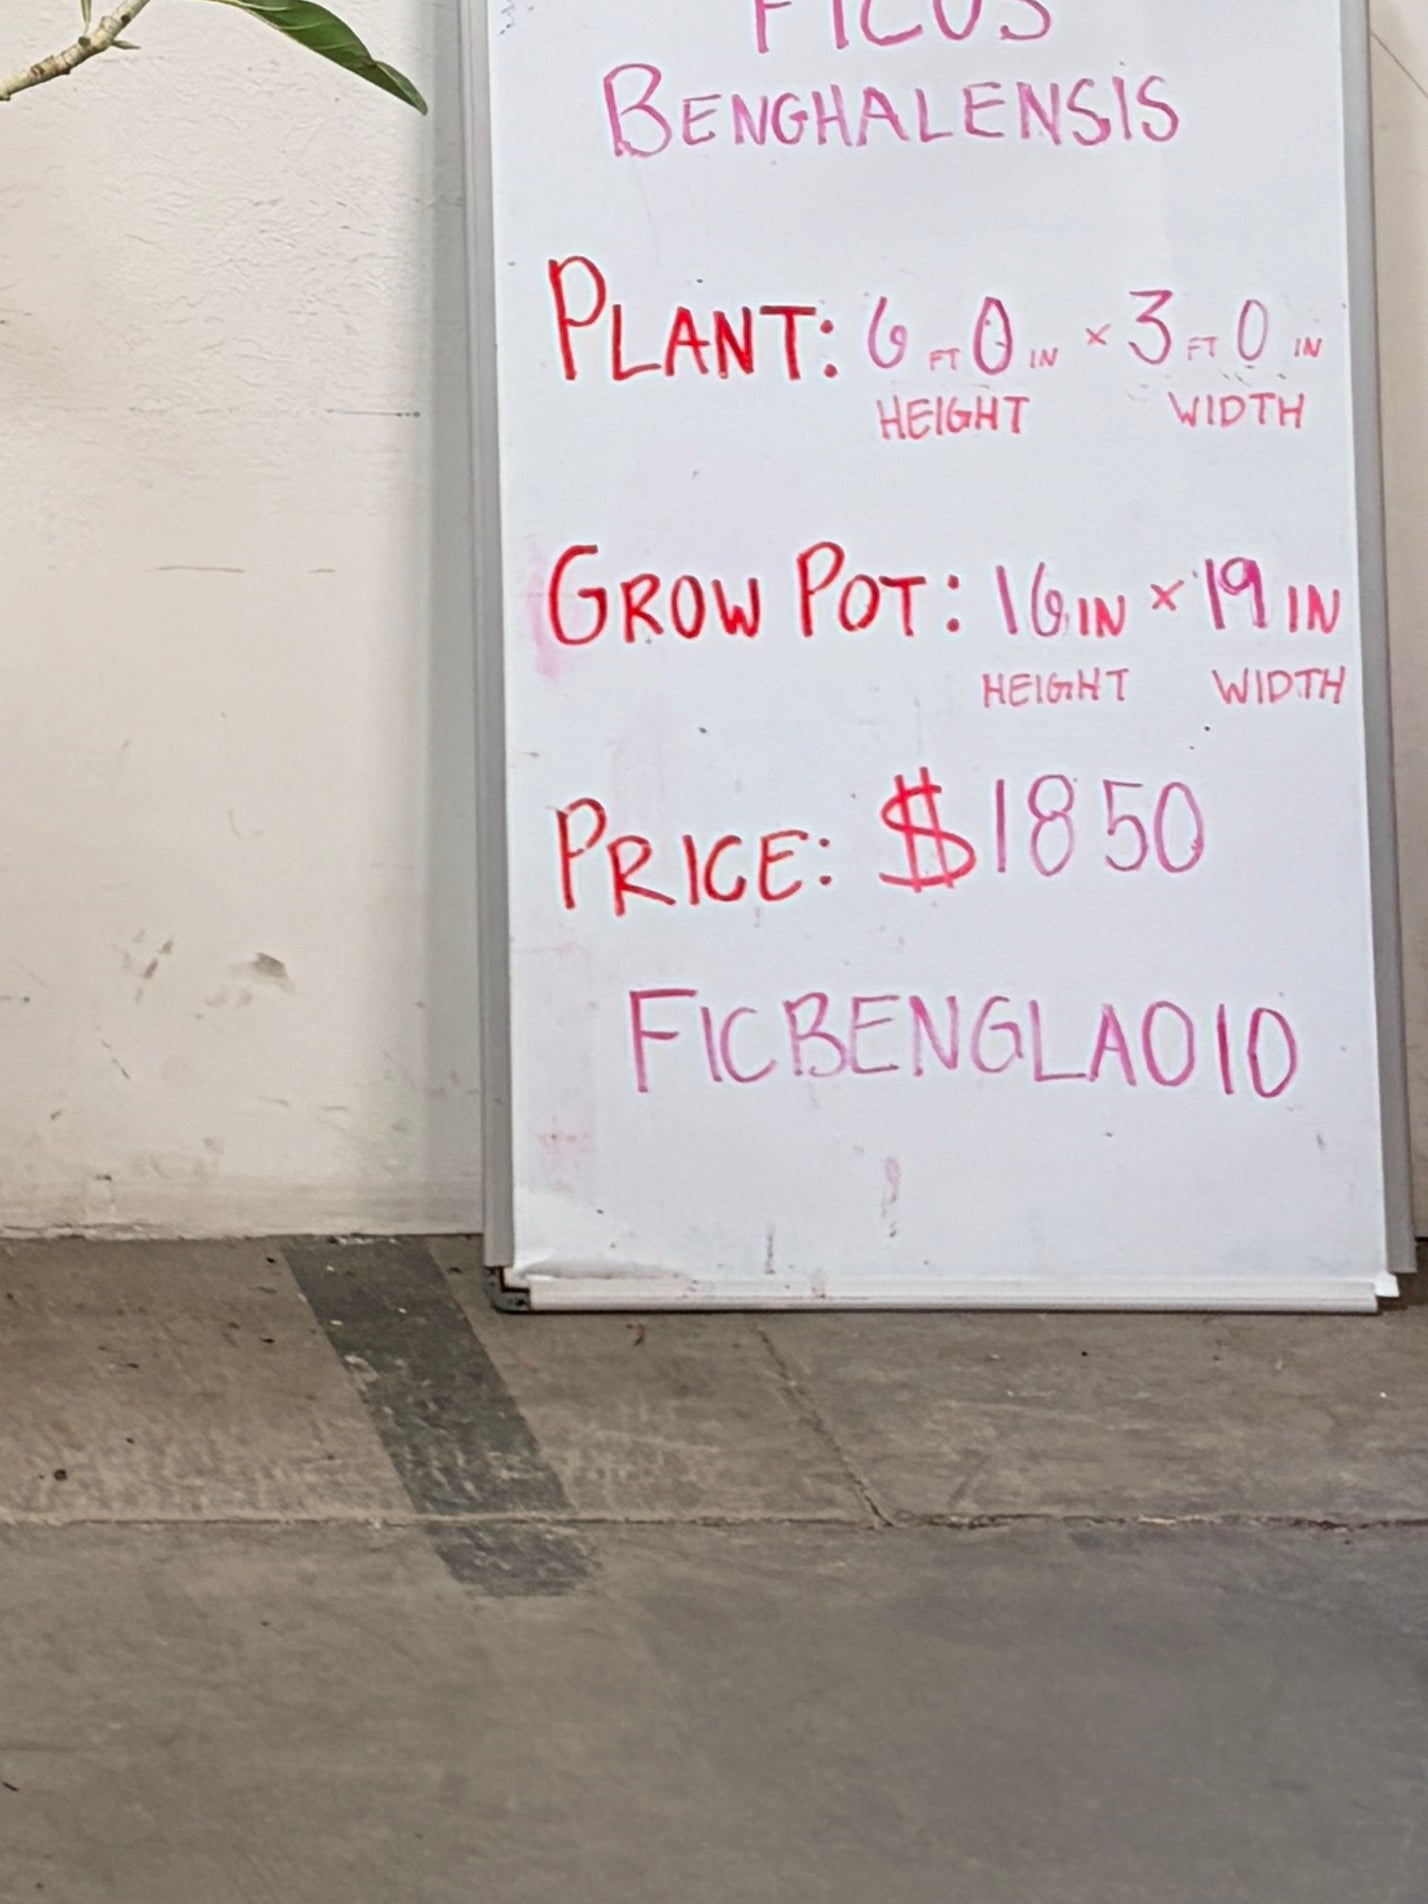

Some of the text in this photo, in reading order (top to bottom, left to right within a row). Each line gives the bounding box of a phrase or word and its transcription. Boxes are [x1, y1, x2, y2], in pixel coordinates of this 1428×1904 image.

[600, 61, 1182, 161] BENGHALENSIS
[545, 254, 840, 384] PLANT:
[926, 346, 959, 370] FT
[970, 295, 1015, 378] 0
[1029, 348, 1059, 370] IN
[1127, 287, 1175, 369] 3
[1187, 334, 1218, 358] FT
[1235, 298, 1265, 363] 0
[1292, 336, 1323, 360] IN
[878, 390, 1306, 442] HEIGHT WIDTH
[543, 542, 764, 649] GROW
[792, 539, 963, 641] POT:
[1286, 584, 1340, 636] IN
[980, 666, 1345, 709] HEIGHT WIDTH
[553, 764, 1207, 920] PRICE: $1850
